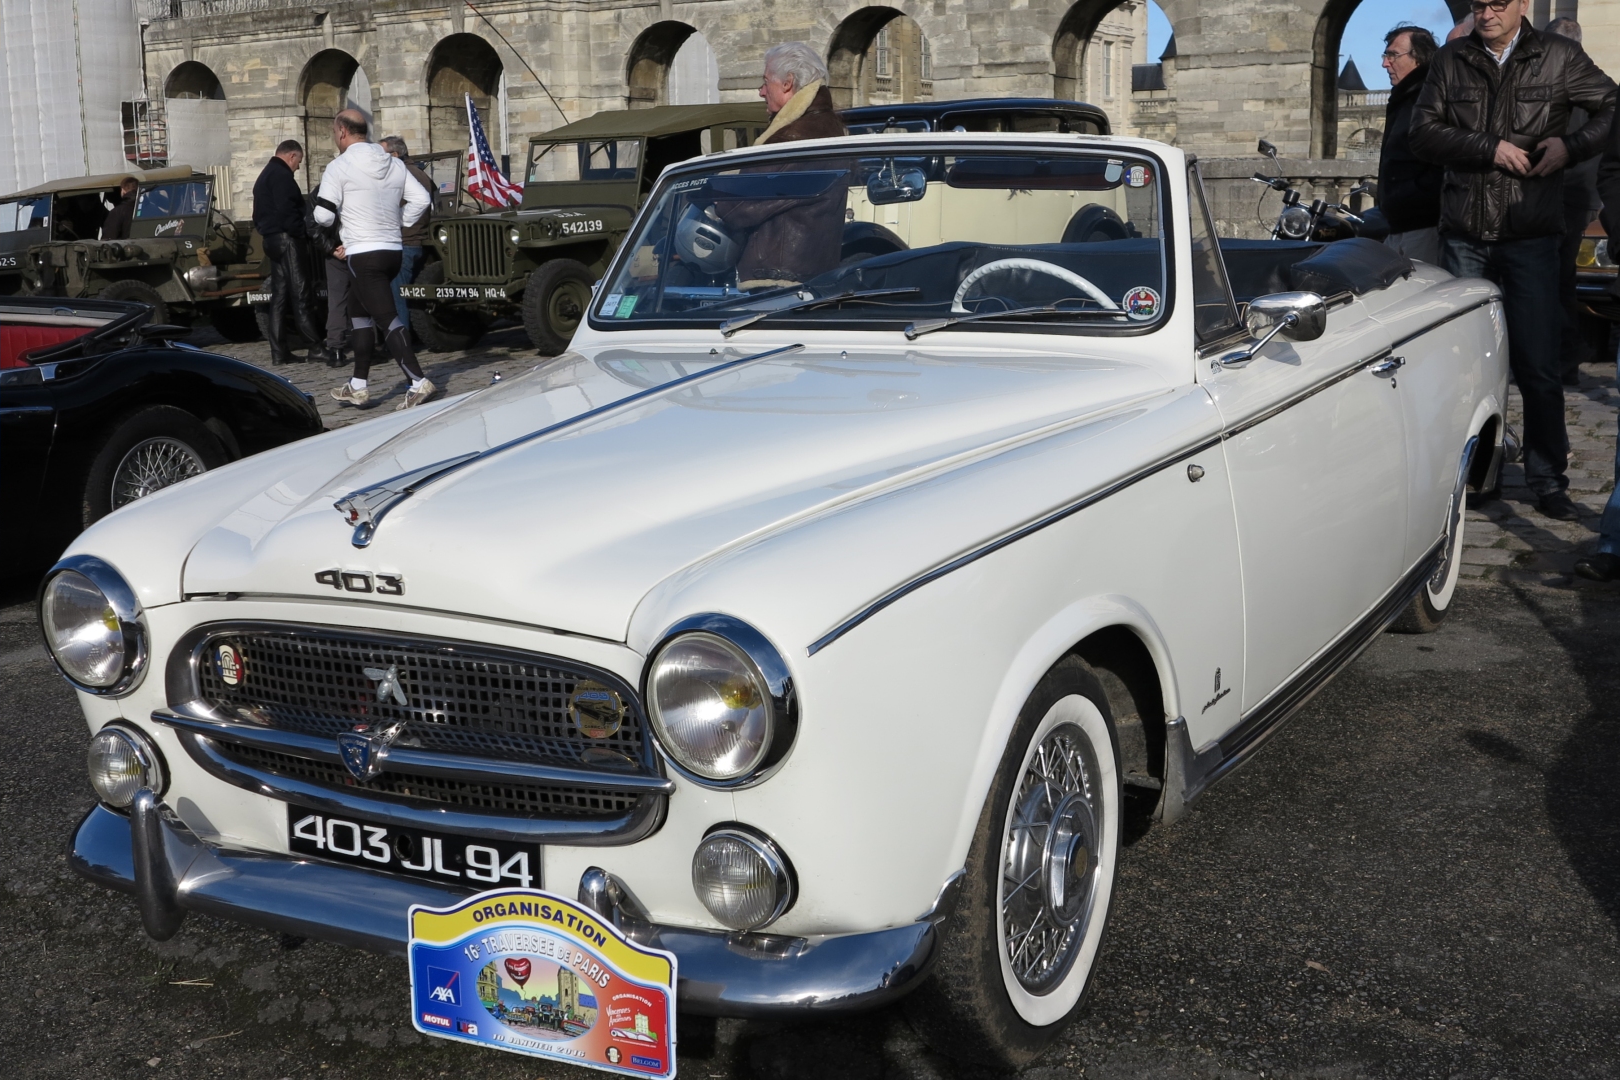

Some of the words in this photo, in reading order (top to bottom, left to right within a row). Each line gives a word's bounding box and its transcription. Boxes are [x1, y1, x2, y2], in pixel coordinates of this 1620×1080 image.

[185, 240, 193, 249] S
[400, 287, 426, 297] 3A-12C
[436, 287, 454, 297] 2139
[455, 287, 467, 297] ZM
[468, 288, 479, 298] 94
[485, 287, 506, 298] HQ-4
[314, 567, 406, 596] 403
[580, 691, 610, 700] 403
[293, 815, 392, 863] 403
[400, 836, 461, 877] JL
[465, 845, 534, 888] 94
[472, 901, 607, 948] ORGANISATION
[481, 933, 555, 958] TRAVERSEE
[557, 945, 571, 963] DE
[572, 951, 611, 989] PARIS
[429, 986, 456, 1004] AXA
[612, 993, 653, 1008] ORGANISATION
[424, 1014, 450, 1027] MOTUL
[492, 1033, 506, 1042] 10
[508, 1037, 553, 1052] JANVIER
[555, 1046, 586, 1058] 2016
[632, 1056, 660, 1068] BELGOM
